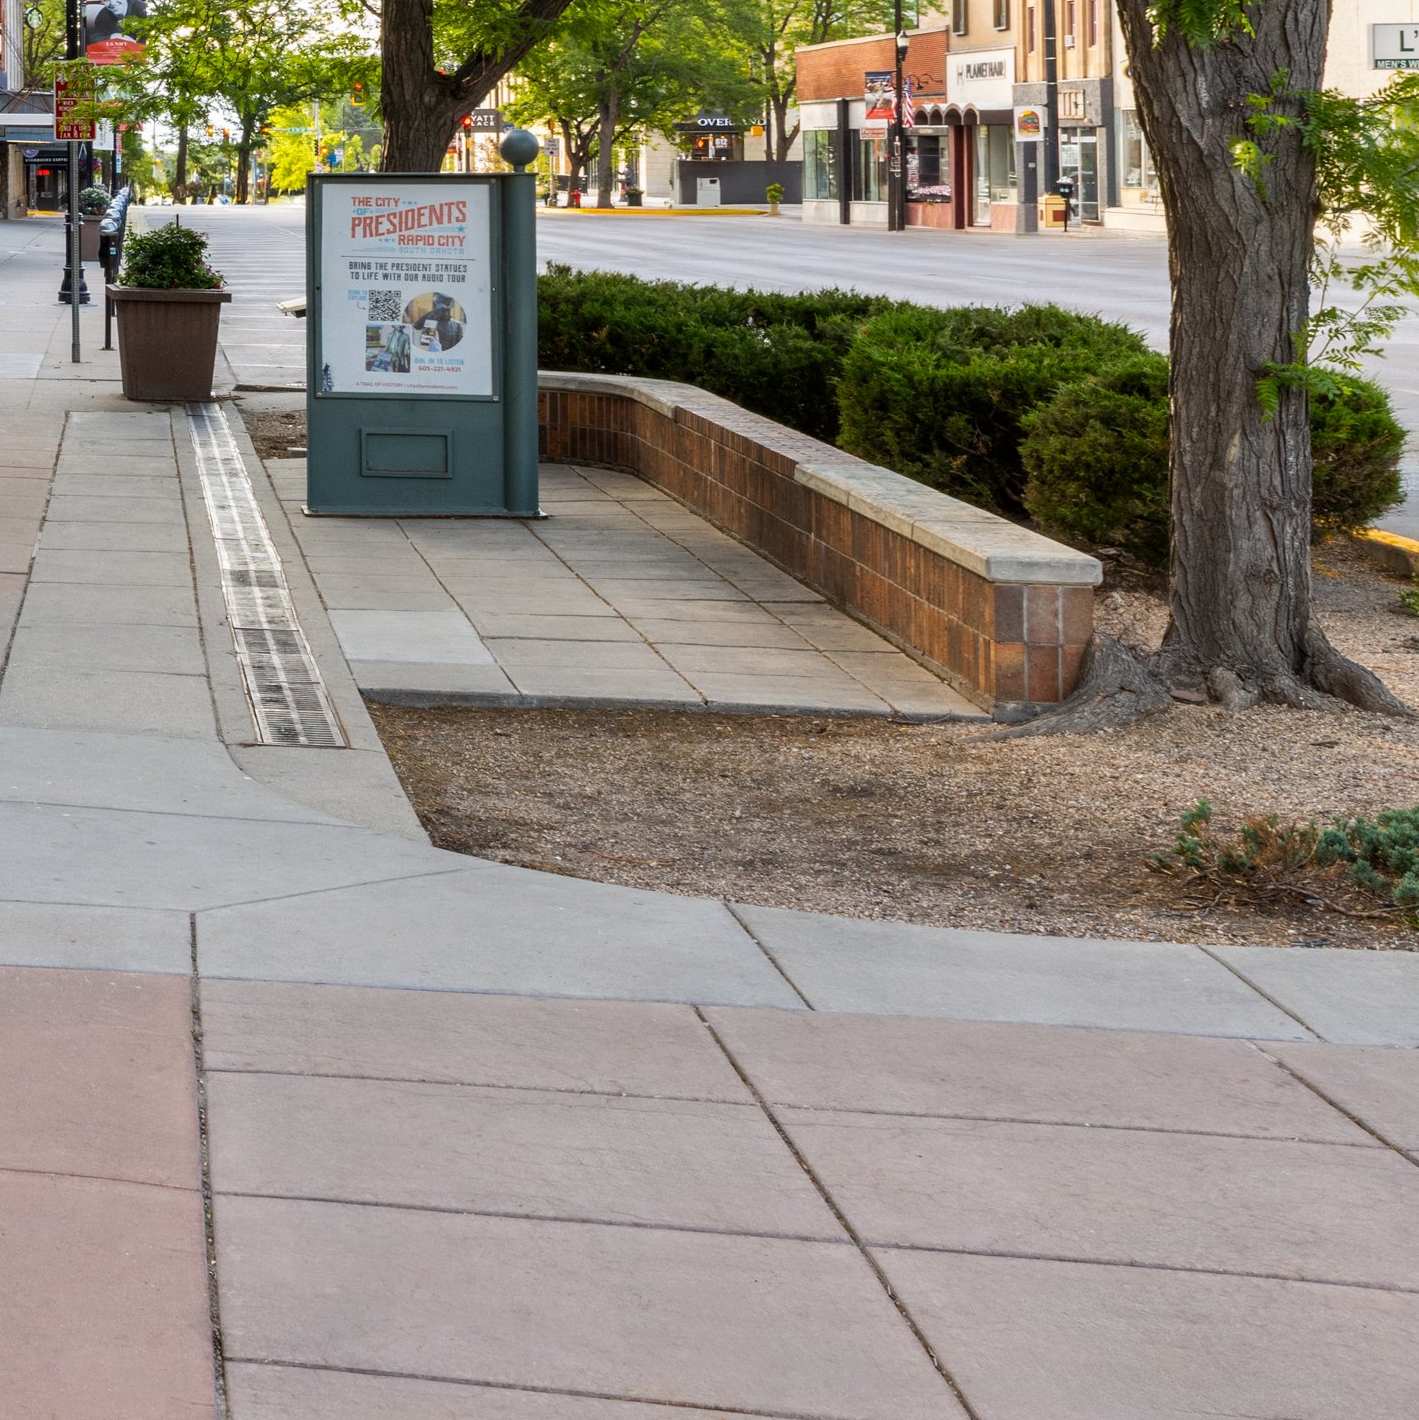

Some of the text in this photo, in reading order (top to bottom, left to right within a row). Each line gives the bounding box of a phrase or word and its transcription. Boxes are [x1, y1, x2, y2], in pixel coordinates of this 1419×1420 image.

[965, 62, 989, 79] PLANET
[1377, 60, 1407, 69] MEN'S
[351, 196, 401, 208] THE CITY
[356, 208, 369, 216] OF
[351, 200, 467, 239] PRESIDENTS
[398, 234, 466, 247] RAPID CITY
[349, 261, 467, 273] BRING THE PRESIDENT STATUES
[350, 271, 466, 283] TO LIFE WITH OUR AUDIO TOUR
[418, 365, 461, 373] 605-221-4921
